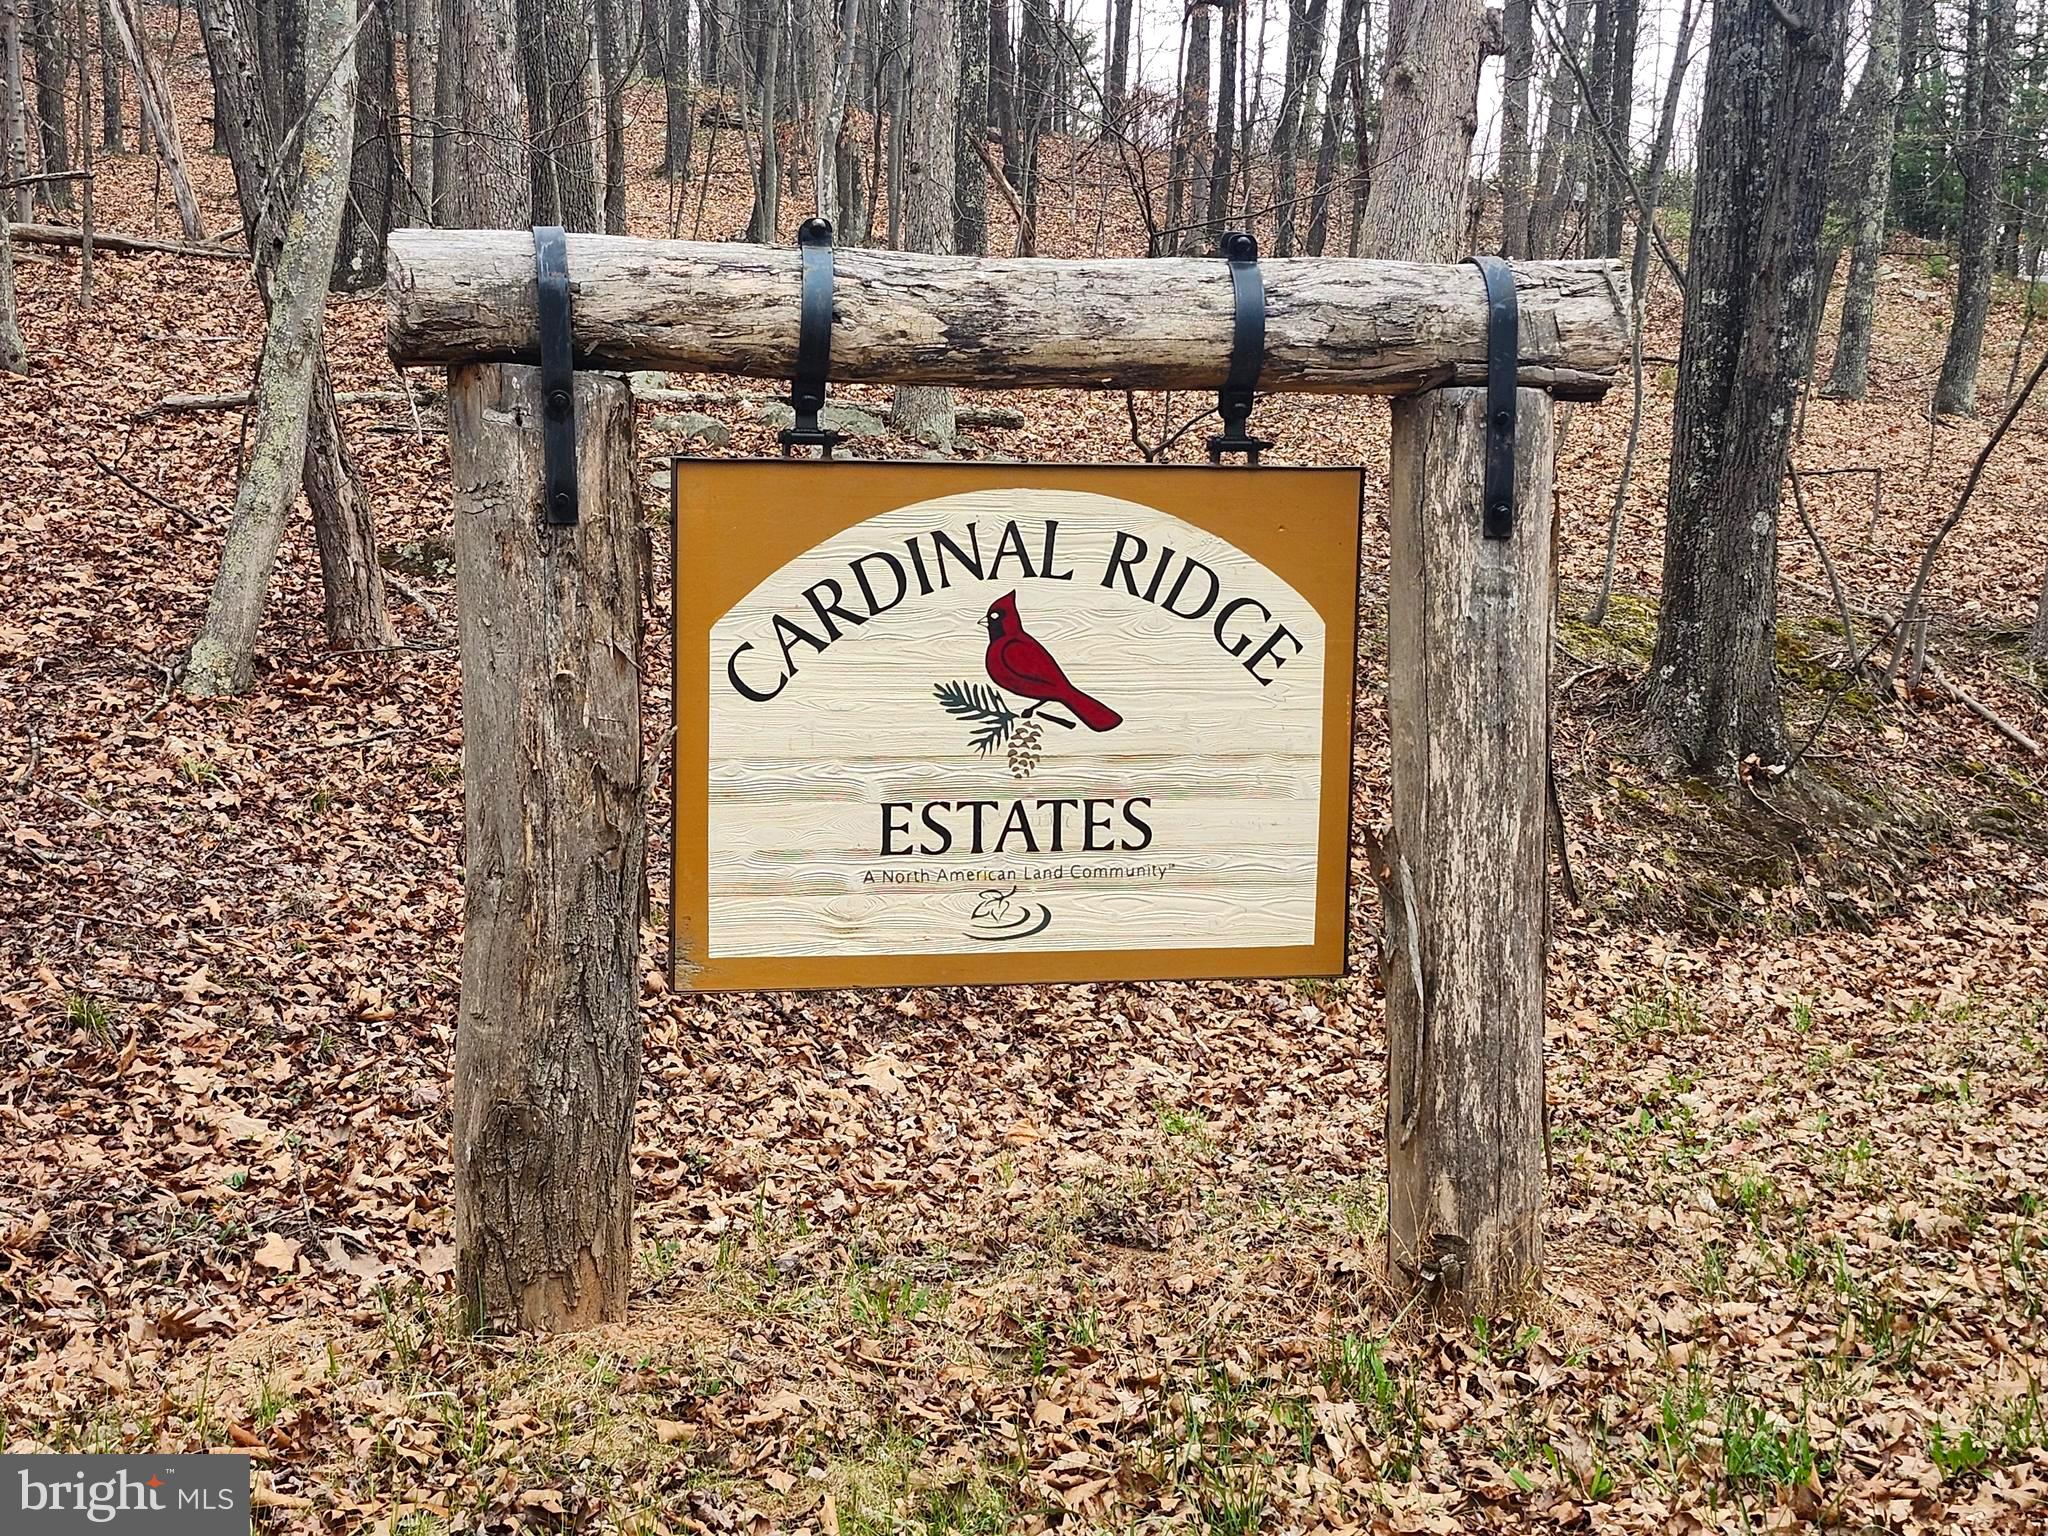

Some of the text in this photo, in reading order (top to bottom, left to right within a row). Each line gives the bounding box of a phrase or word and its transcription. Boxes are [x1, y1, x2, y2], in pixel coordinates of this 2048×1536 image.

[727, 520, 1303, 702] CARDINAL RIDGE
[880, 797, 1153, 856] ESTATES
[863, 869, 876, 884] A
[882, 868, 930, 884] North
[936, 867, 1017, 882] American
[1024, 866, 1063, 880] Land
